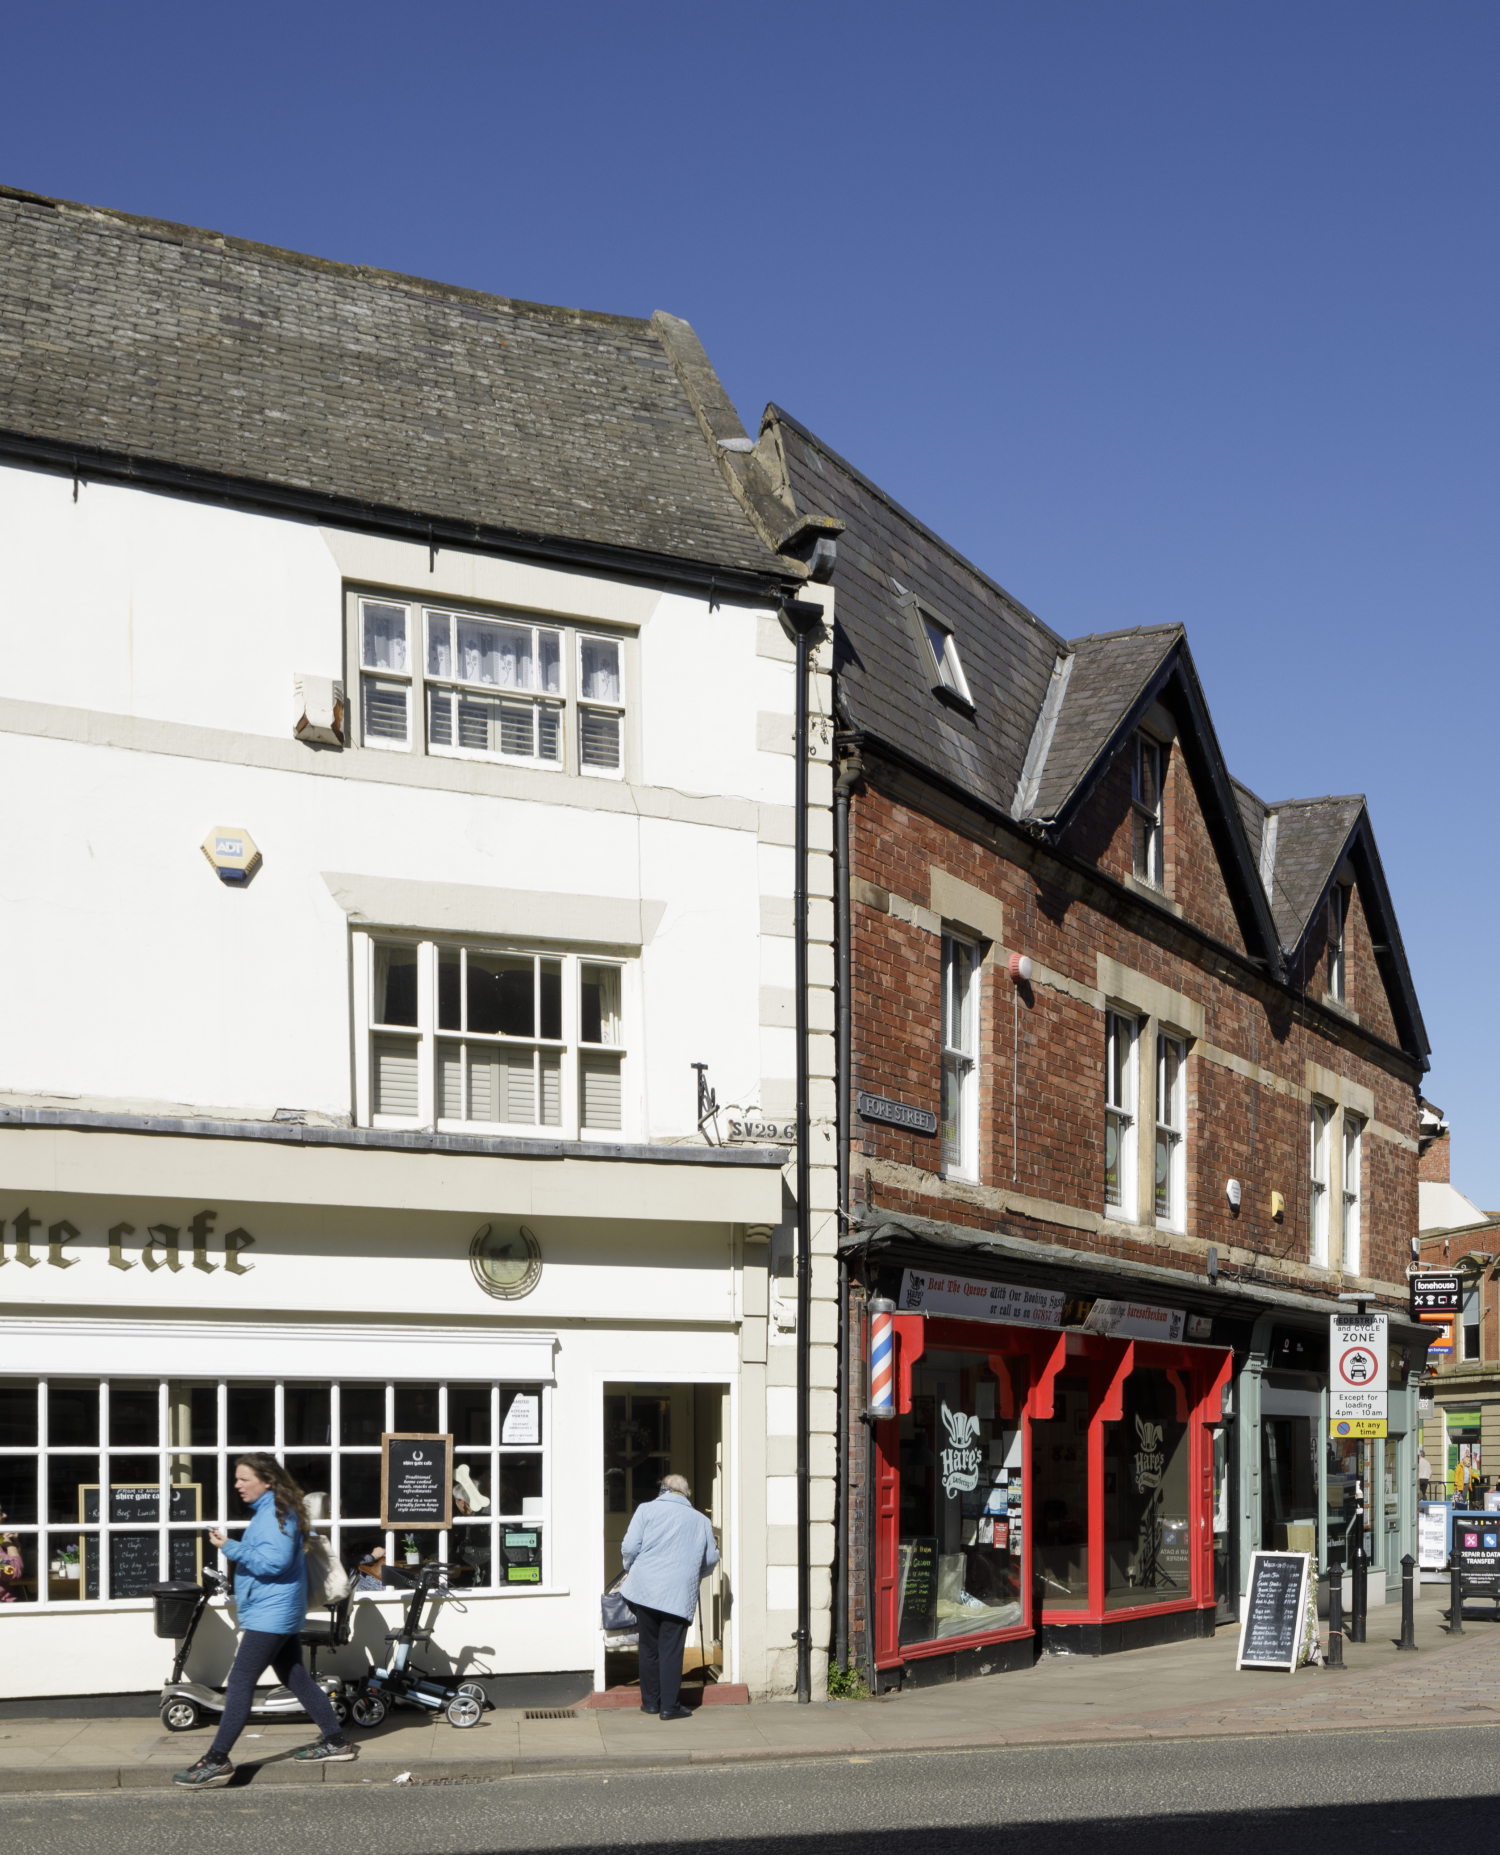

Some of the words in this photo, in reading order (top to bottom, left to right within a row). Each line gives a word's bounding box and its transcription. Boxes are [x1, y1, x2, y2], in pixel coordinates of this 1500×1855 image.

[216, 841, 243, 854] ADT
[866, 1098, 892, 1118] FORE
[894, 1106, 931, 1128] STREET
[107, 1209, 257, 1277] cafe
[927, 1277, 945, 1291] Beat
[947, 1280, 961, 1294] The
[963, 1282, 988, 1297] Queues
[1009, 1289, 1022, 1302] Our
[1023, 1291, 1048, 1307] Booking
[1417, 1281, 1455, 1290] fonehouse
[990, 1304, 998, 1314] or
[999, 1304, 1011, 1316] call
[1013, 1308, 1021, 1318] us
[1342, 1333, 1375, 1342] ZONE
[1339, 1394, 1364, 1402] Except
[1345, 1402, 1372, 1410] loading
[940, 1447, 982, 1476] Hare's
[1134, 1452, 1164, 1474] Hare's
